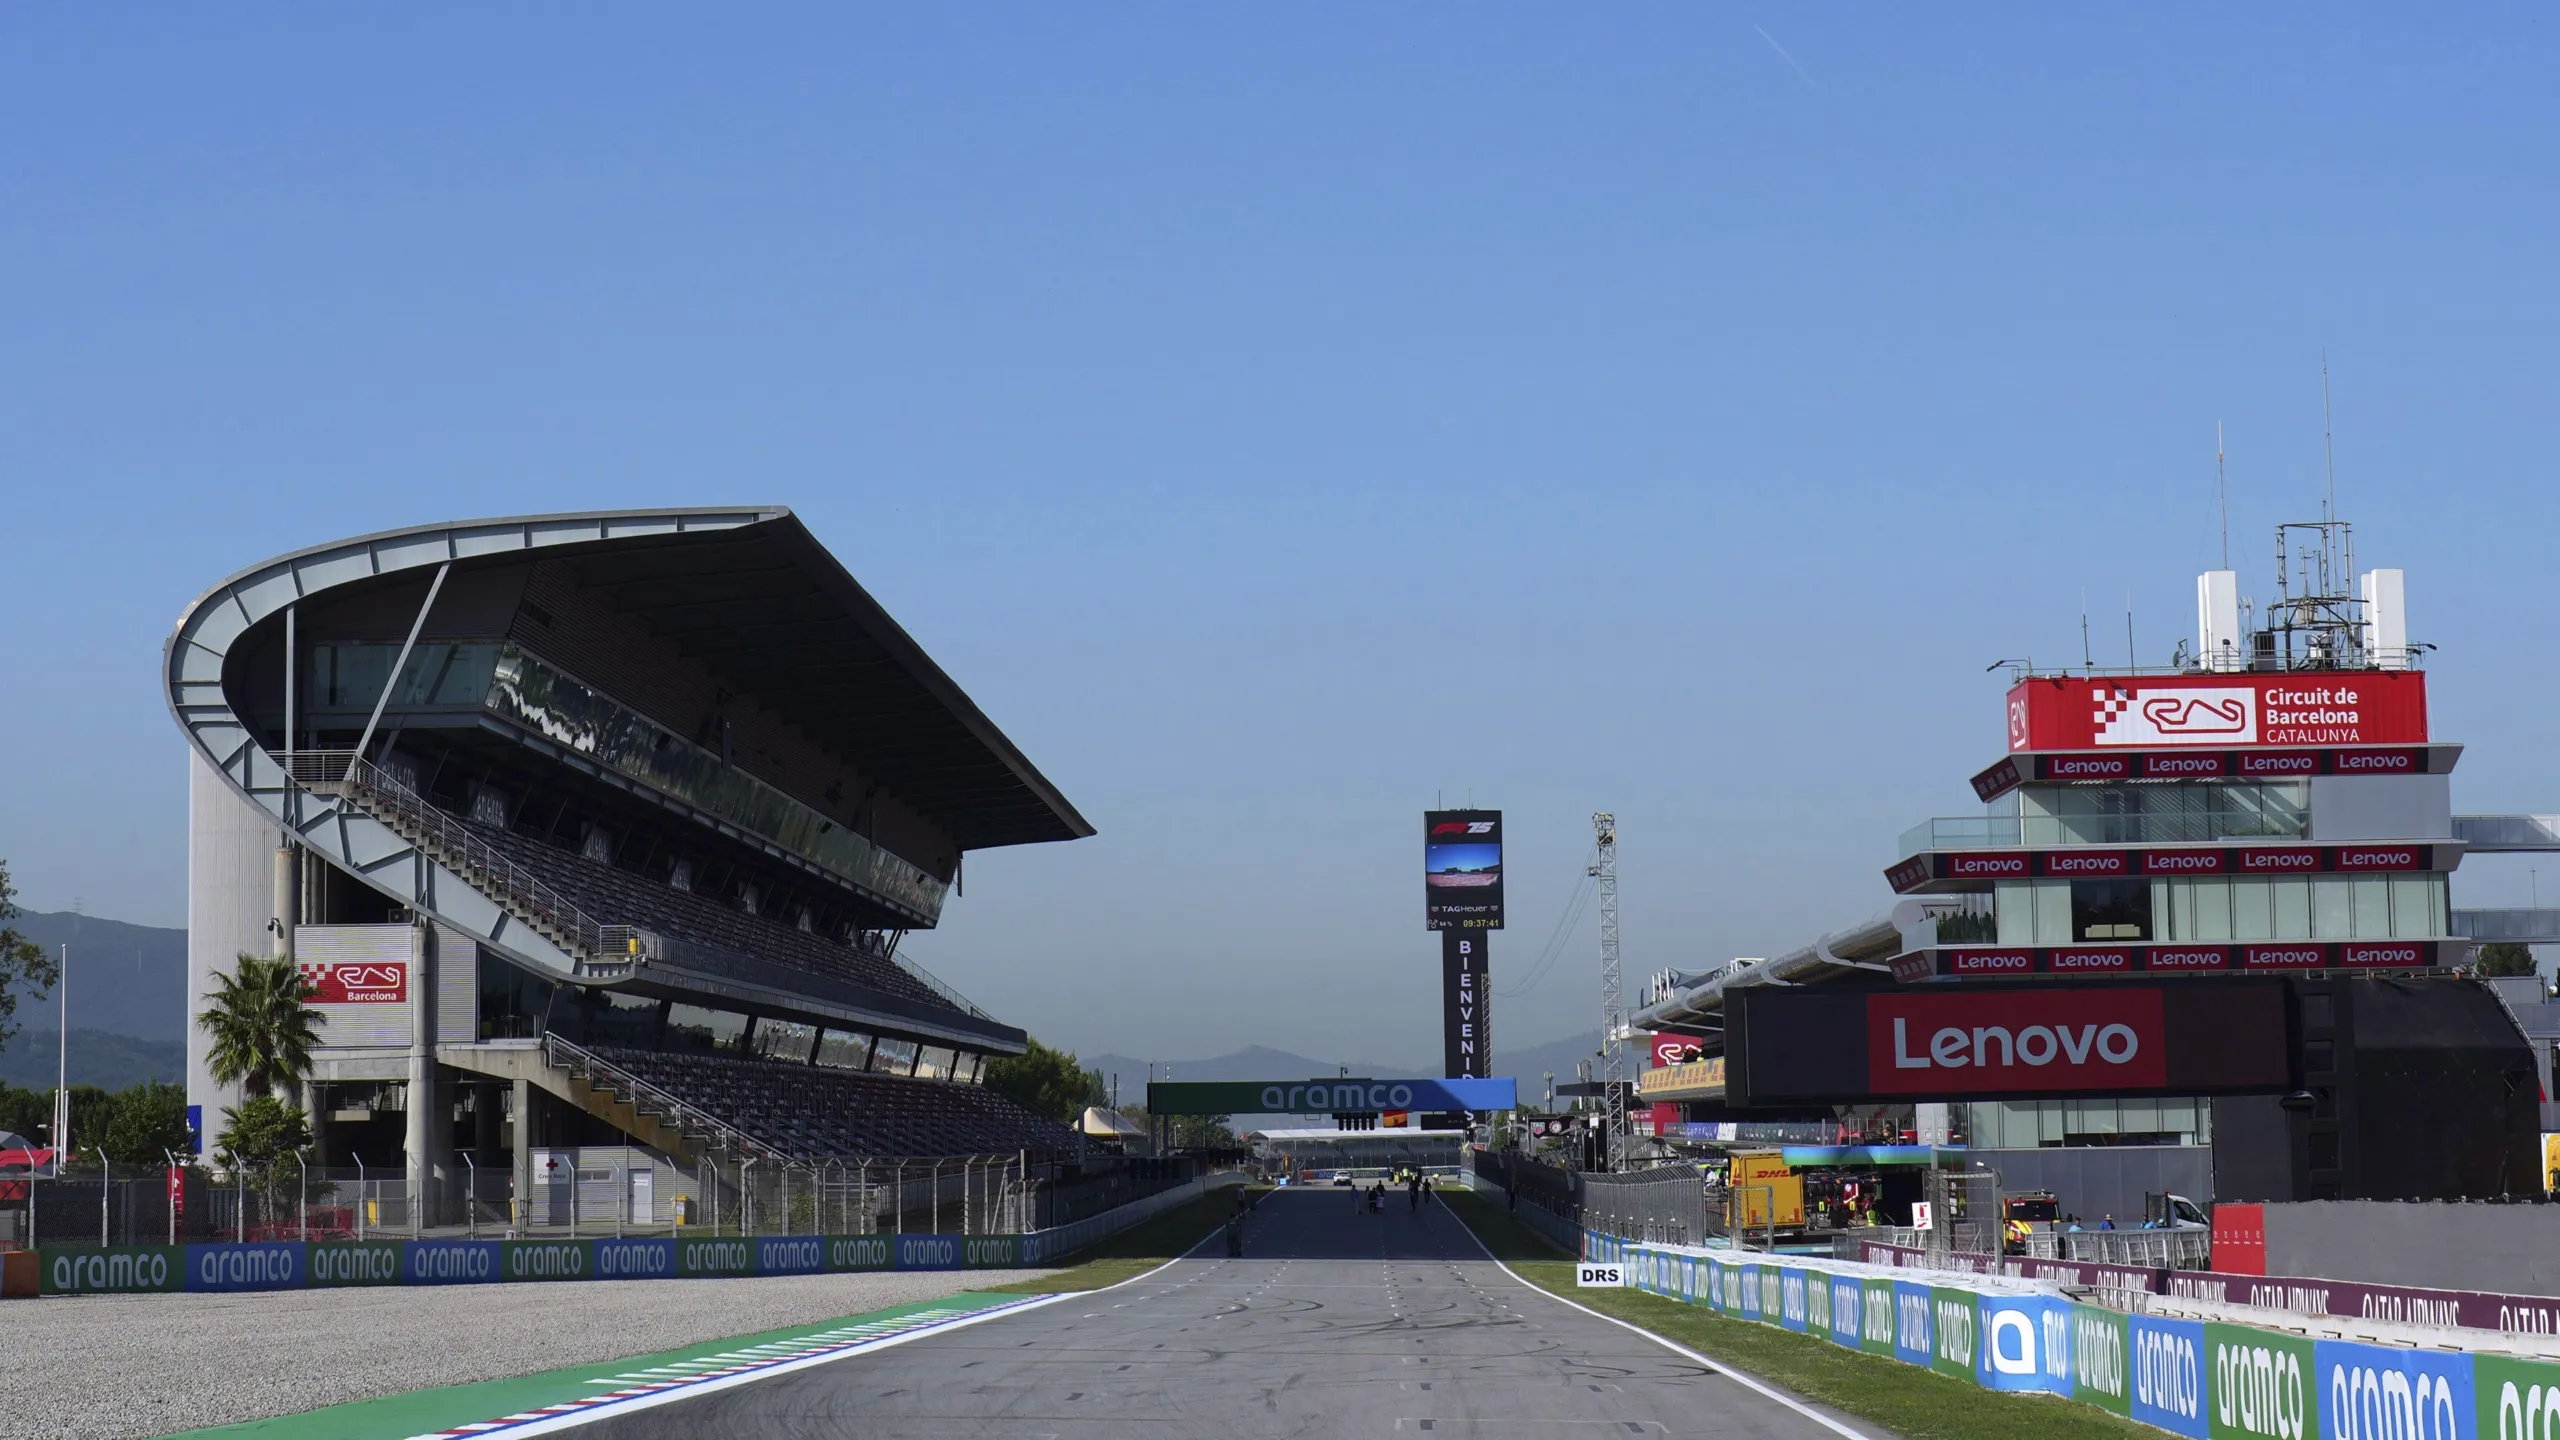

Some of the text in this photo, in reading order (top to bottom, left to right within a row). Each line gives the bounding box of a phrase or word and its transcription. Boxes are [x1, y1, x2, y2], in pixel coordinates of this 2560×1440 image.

[2265, 687, 2358, 706] Circuit de
[2266, 707, 2359, 725] Barcelona
[2266, 728, 2360, 743] CATALUNYA
[2055, 759, 2123, 773] Lenovo
[2149, 757, 2217, 772] Lenovo
[2244, 755, 2313, 770] Lenovo
[2339, 754, 2408, 769] Lenovo
[1954, 858, 2023, 872] Lenovo
[2051, 856, 2120, 871] Lenovo
[2148, 854, 2217, 869] Lenovo
[2245, 852, 2314, 867] Lenovo
[2342, 851, 2411, 866] Lenovo
[1958, 954, 2027, 969] Lenovo
[2055, 952, 2124, 967] Lenovo
[2152, 951, 2222, 966] Lenovo
[2249, 949, 2319, 964] Lenovo
[2346, 947, 2416, 962] Lenovo
[347, 990, 397, 1001] Barcelona
[1893, 1017, 2139, 1069] Lenovo
[1261, 1084, 1413, 1109] aramco
[1756, 1169, 1790, 1179] DHL
[512, 1245, 582, 1276] aramco
[601, 1244, 666, 1274] aramco
[686, 1242, 747, 1271] aramco
[763, 1240, 820, 1269] aramco
[833, 1239, 886, 1266] aramco
[903, 1239, 953, 1265] aramco
[967, 1239, 1013, 1264] aramco
[54, 1253, 167, 1289] aramco
[201, 1248, 293, 1284] aramco
[314, 1247, 395, 1280] aramco
[415, 1247, 489, 1278] aramco
[1582, 1269, 1619, 1282] DRS
[2078, 1316, 2122, 1398] aramco
[2137, 1327, 2197, 1420] aramco
[2217, 1342, 2303, 1440] aramco
[2332, 1363, 2456, 1440] aramco
